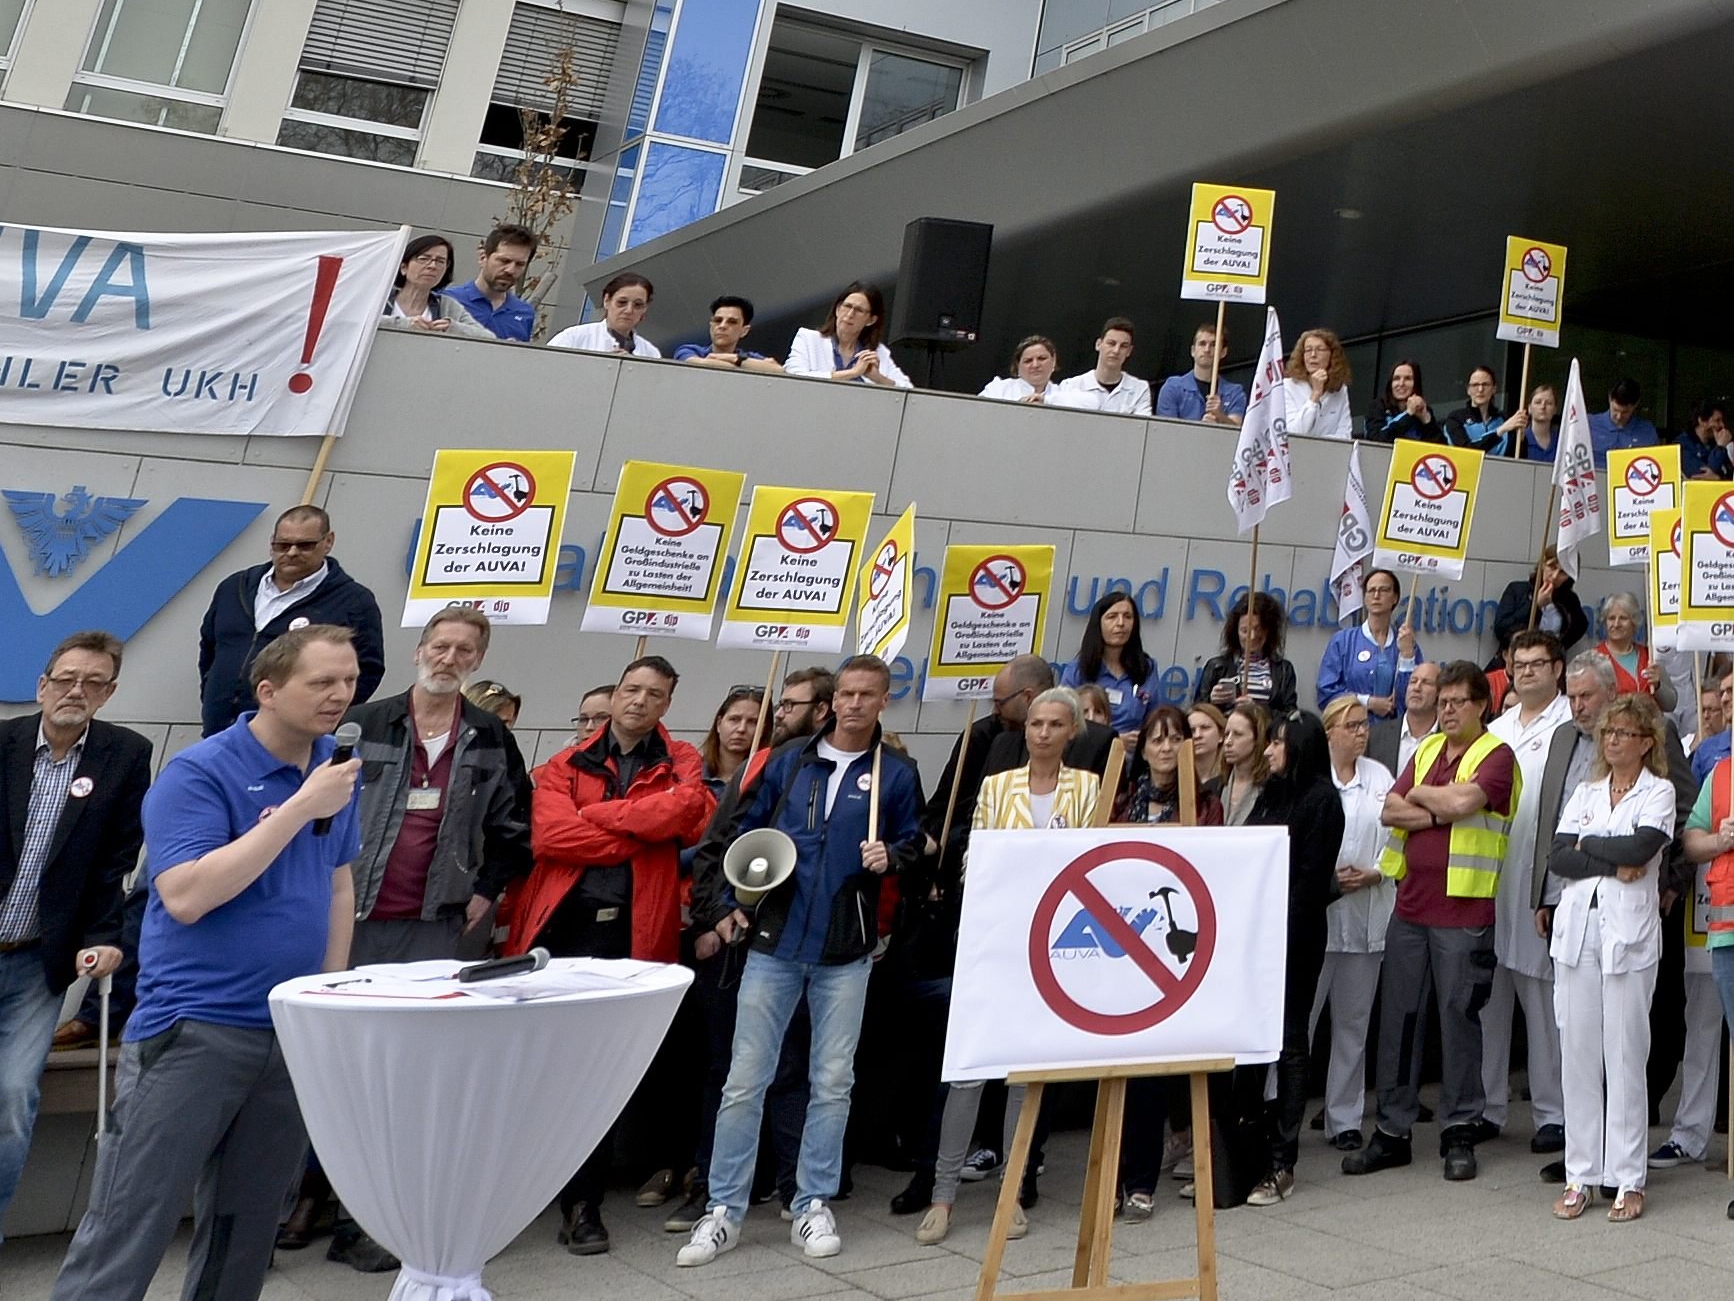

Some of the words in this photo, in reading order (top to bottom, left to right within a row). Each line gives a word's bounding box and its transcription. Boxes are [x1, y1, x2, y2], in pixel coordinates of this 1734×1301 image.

[1217, 235, 1242, 243] Keine
[1198, 245, 1258, 259] Zerschlagung
[1222, 259, 1251, 268] AUVA!
[0, 225, 150, 330] VA
[162, 367, 259, 401] UKH
[1414, 499, 1442, 511] Keine
[1392, 509, 1459, 529] Zerschlagung
[469, 525, 514, 536] Keine
[1397, 524, 1414, 534] der
[1417, 527, 1449, 539] AUVA!
[655, 537, 682, 547] Keine
[435, 543, 541, 557] Zerschlagung
[621, 545, 694, 559] Geldgeschenke
[443, 561, 470, 573] der
[475, 561, 526, 572] AUVA!
[624, 557, 700, 571] Großindustrielle
[780, 555, 818, 567] Keine
[643, 570, 673, 580] Lasten
[676, 573, 692, 581] der
[750, 570, 840, 588] Zerschlagung
[622, 579, 692, 592] Allgemeinheit!
[756, 588, 779, 599] der
[782, 590, 827, 602] AUVA!
[1068, 567, 1170, 620] und
[622, 611, 657, 624] GPA
[755, 625, 789, 638] GPA
[951, 620, 1016, 630] Geldgeschenke
[955, 630, 1024, 639] Großindustrielle
[972, 641, 1000, 649] Lasten
[1049, 949, 1101, 960] AUVA
